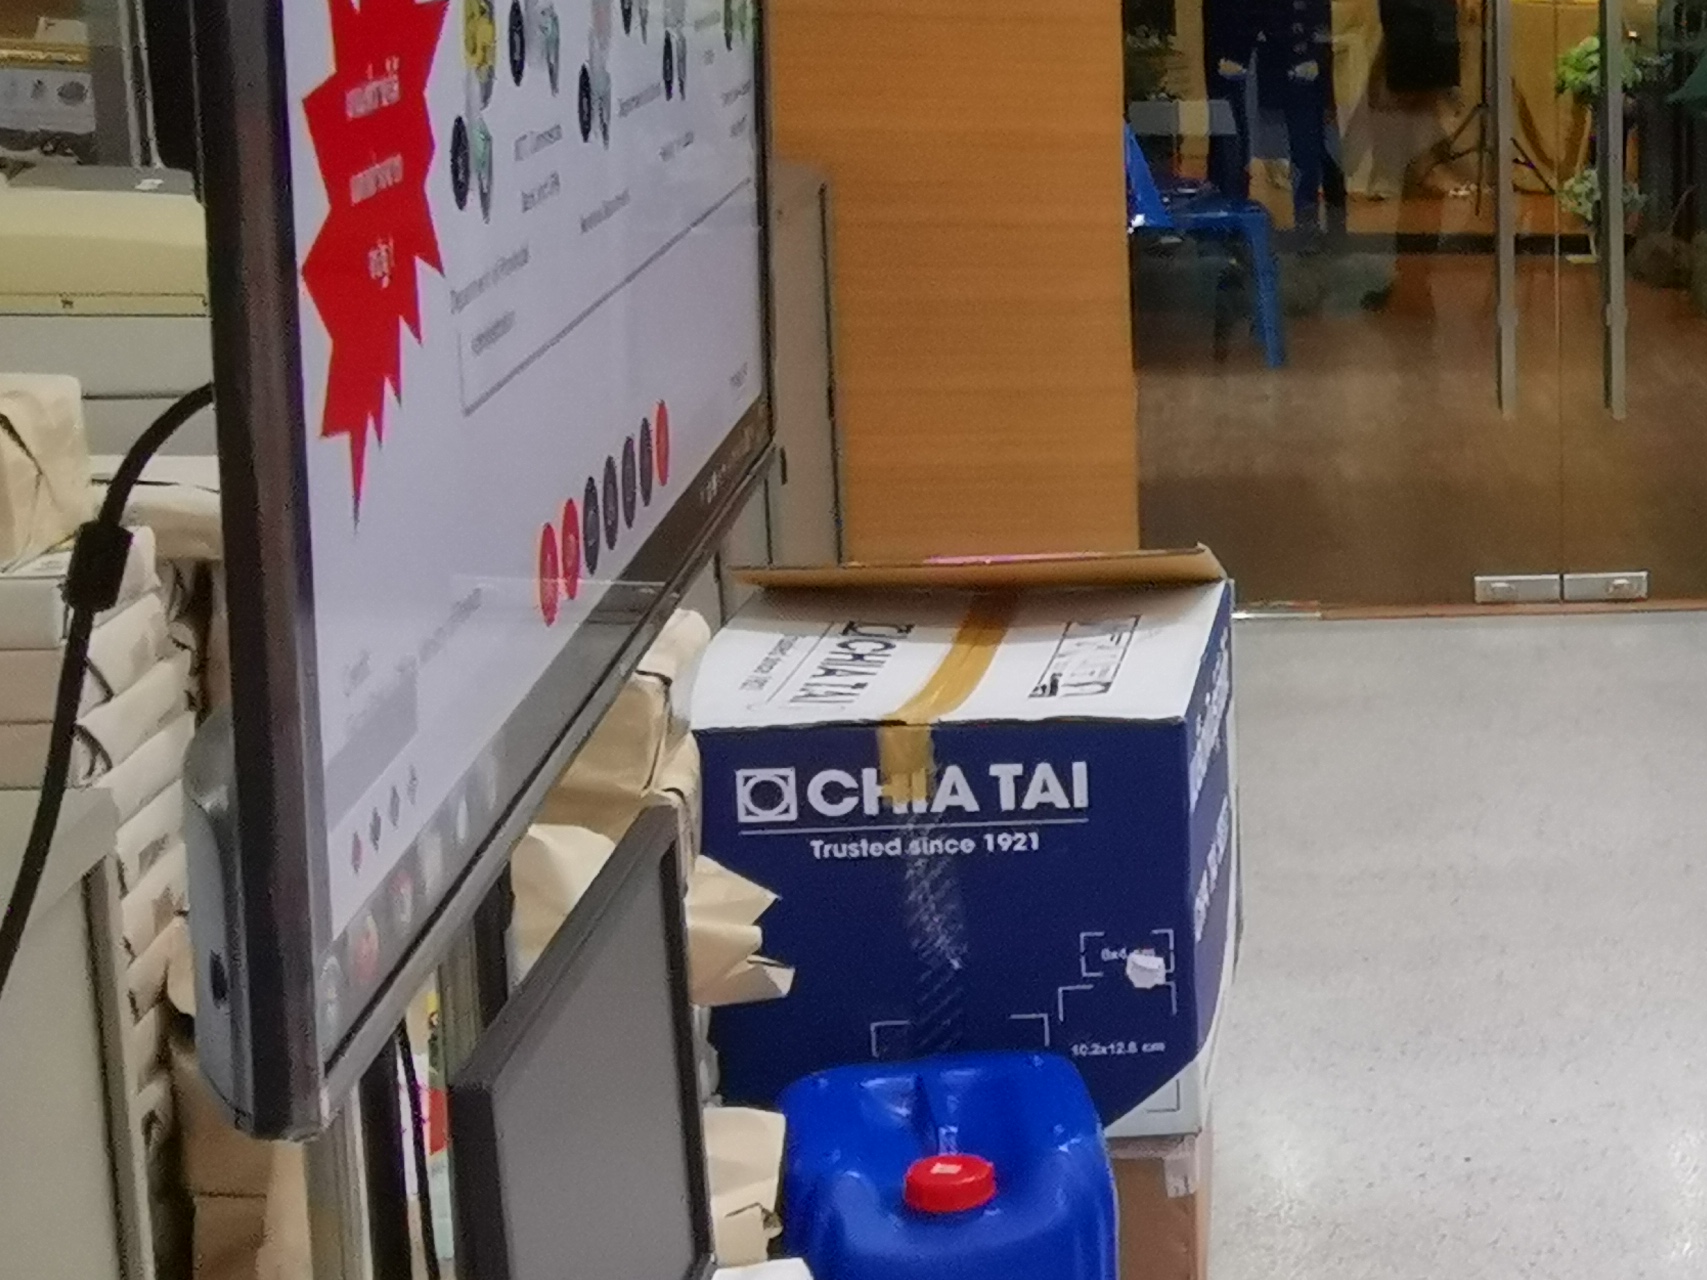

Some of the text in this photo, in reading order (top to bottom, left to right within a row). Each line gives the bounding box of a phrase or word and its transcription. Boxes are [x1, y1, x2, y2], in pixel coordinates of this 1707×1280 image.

[806, 760, 1090, 818] CHIA TAI
[809, 831, 1041, 860] Trusted since 1921
